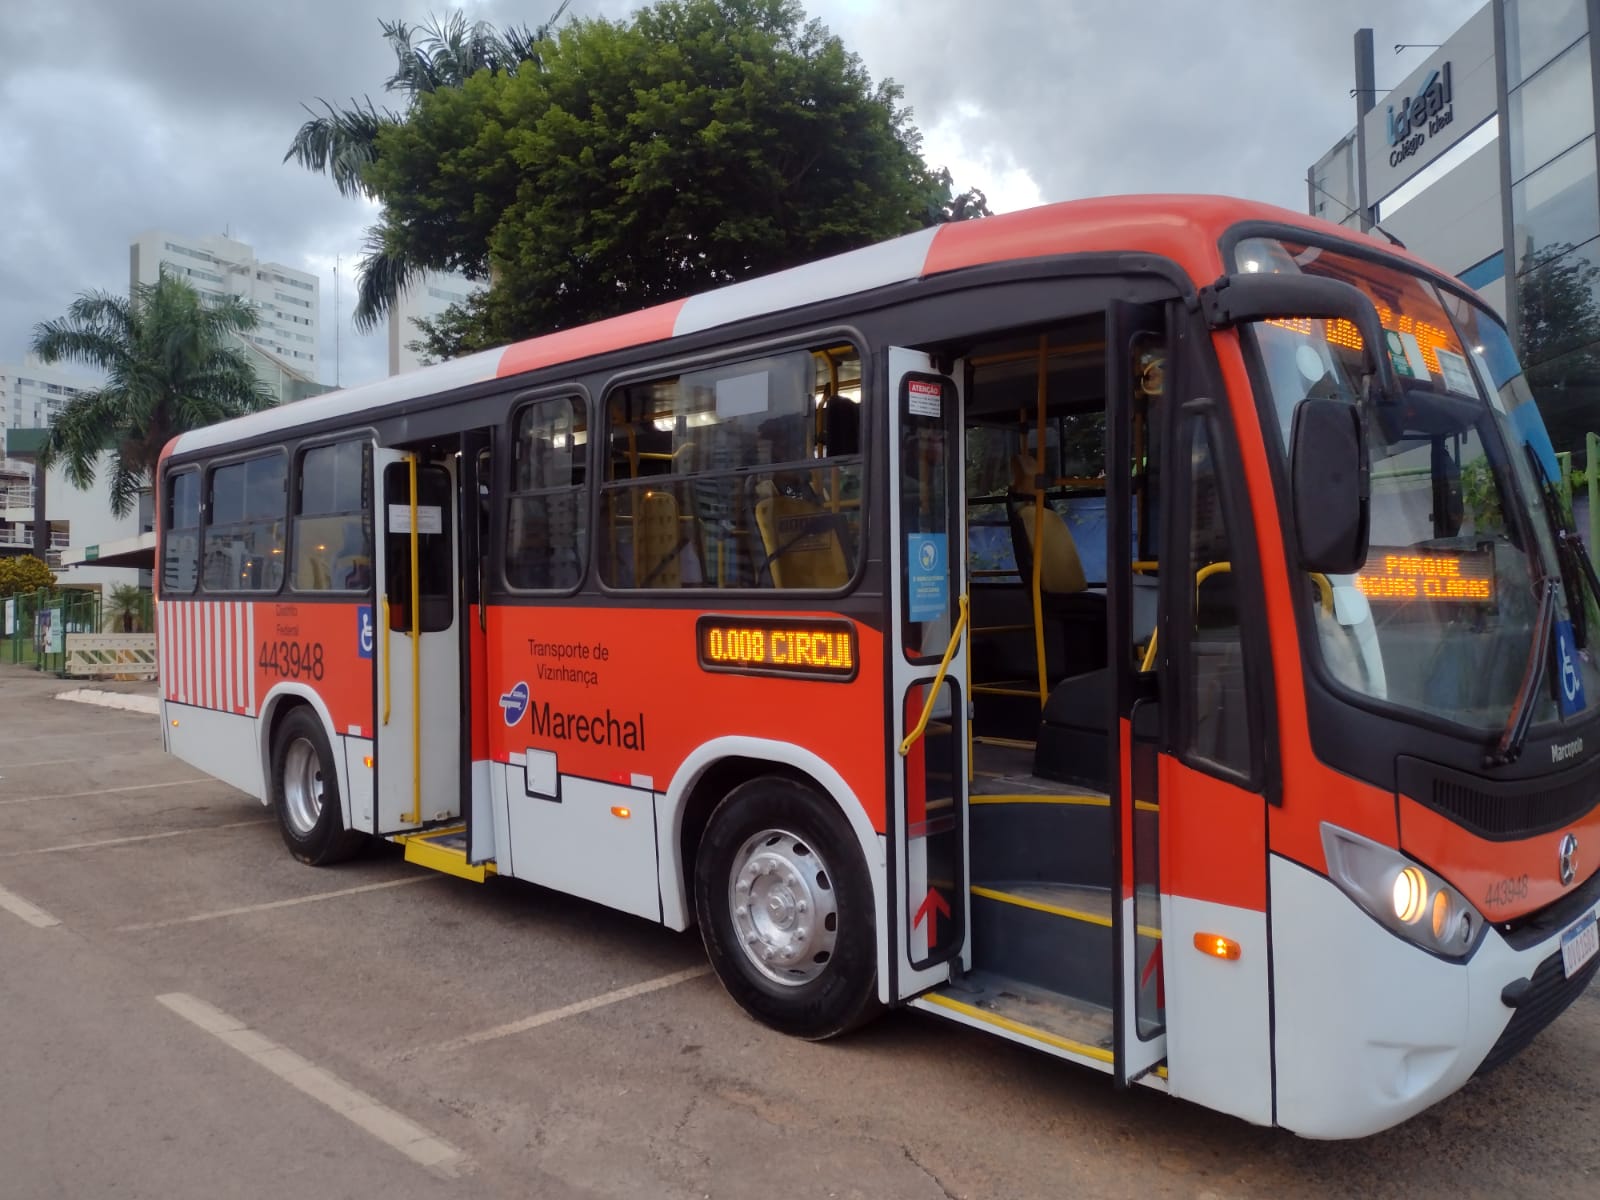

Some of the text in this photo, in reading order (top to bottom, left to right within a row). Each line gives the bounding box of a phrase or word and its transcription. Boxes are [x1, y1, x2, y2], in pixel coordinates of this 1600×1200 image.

[912, 384, 938, 394] ATENÇÃO
[1386, 556, 1460, 577] PARQUE
[1423, 579, 1489, 596] CLARAS
[259, 641, 324, 681] 443948
[527, 638, 609, 662] Transporte de
[537, 663, 599, 688] Vizinhança
[530, 700, 646, 751] Marechal
[1551, 737, 1583, 763] Marcopolo
